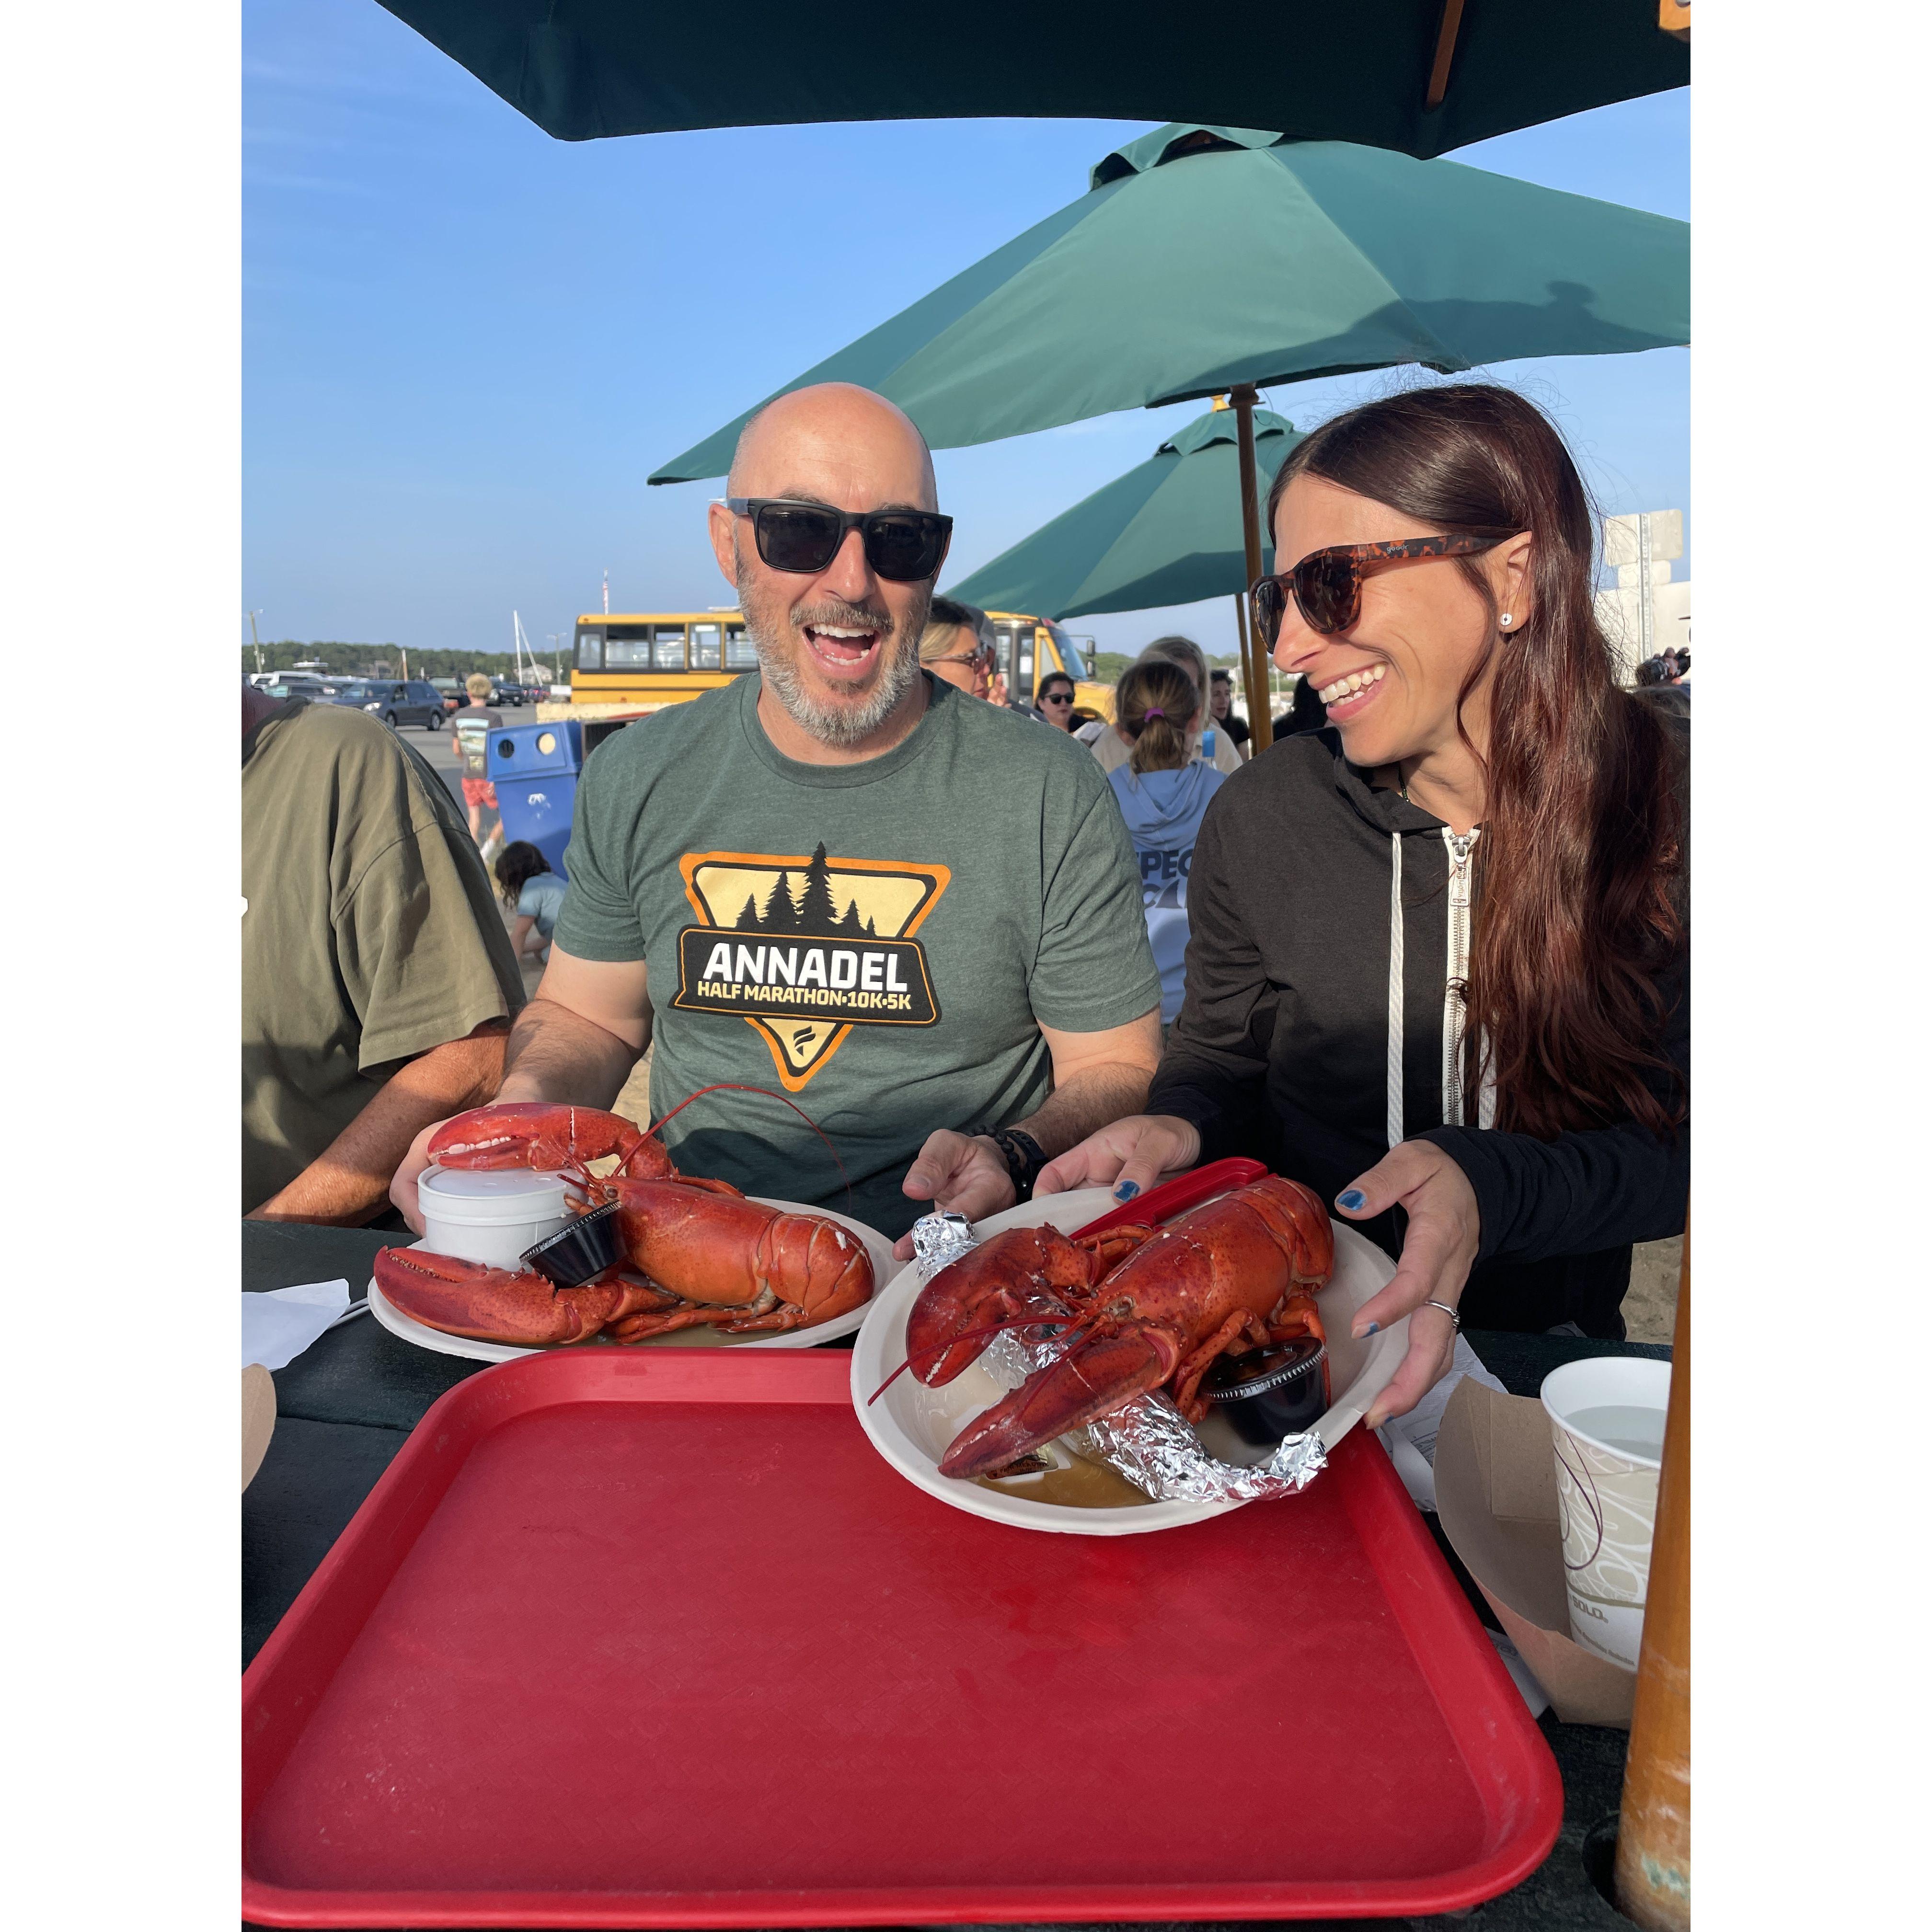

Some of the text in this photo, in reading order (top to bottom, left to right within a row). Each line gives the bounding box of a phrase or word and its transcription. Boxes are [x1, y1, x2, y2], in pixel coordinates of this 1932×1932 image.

[1387, 544, 1410, 554] goodr
[702, 943, 908, 992] ANNADEL
[698, 980, 741, 1000] HALF
